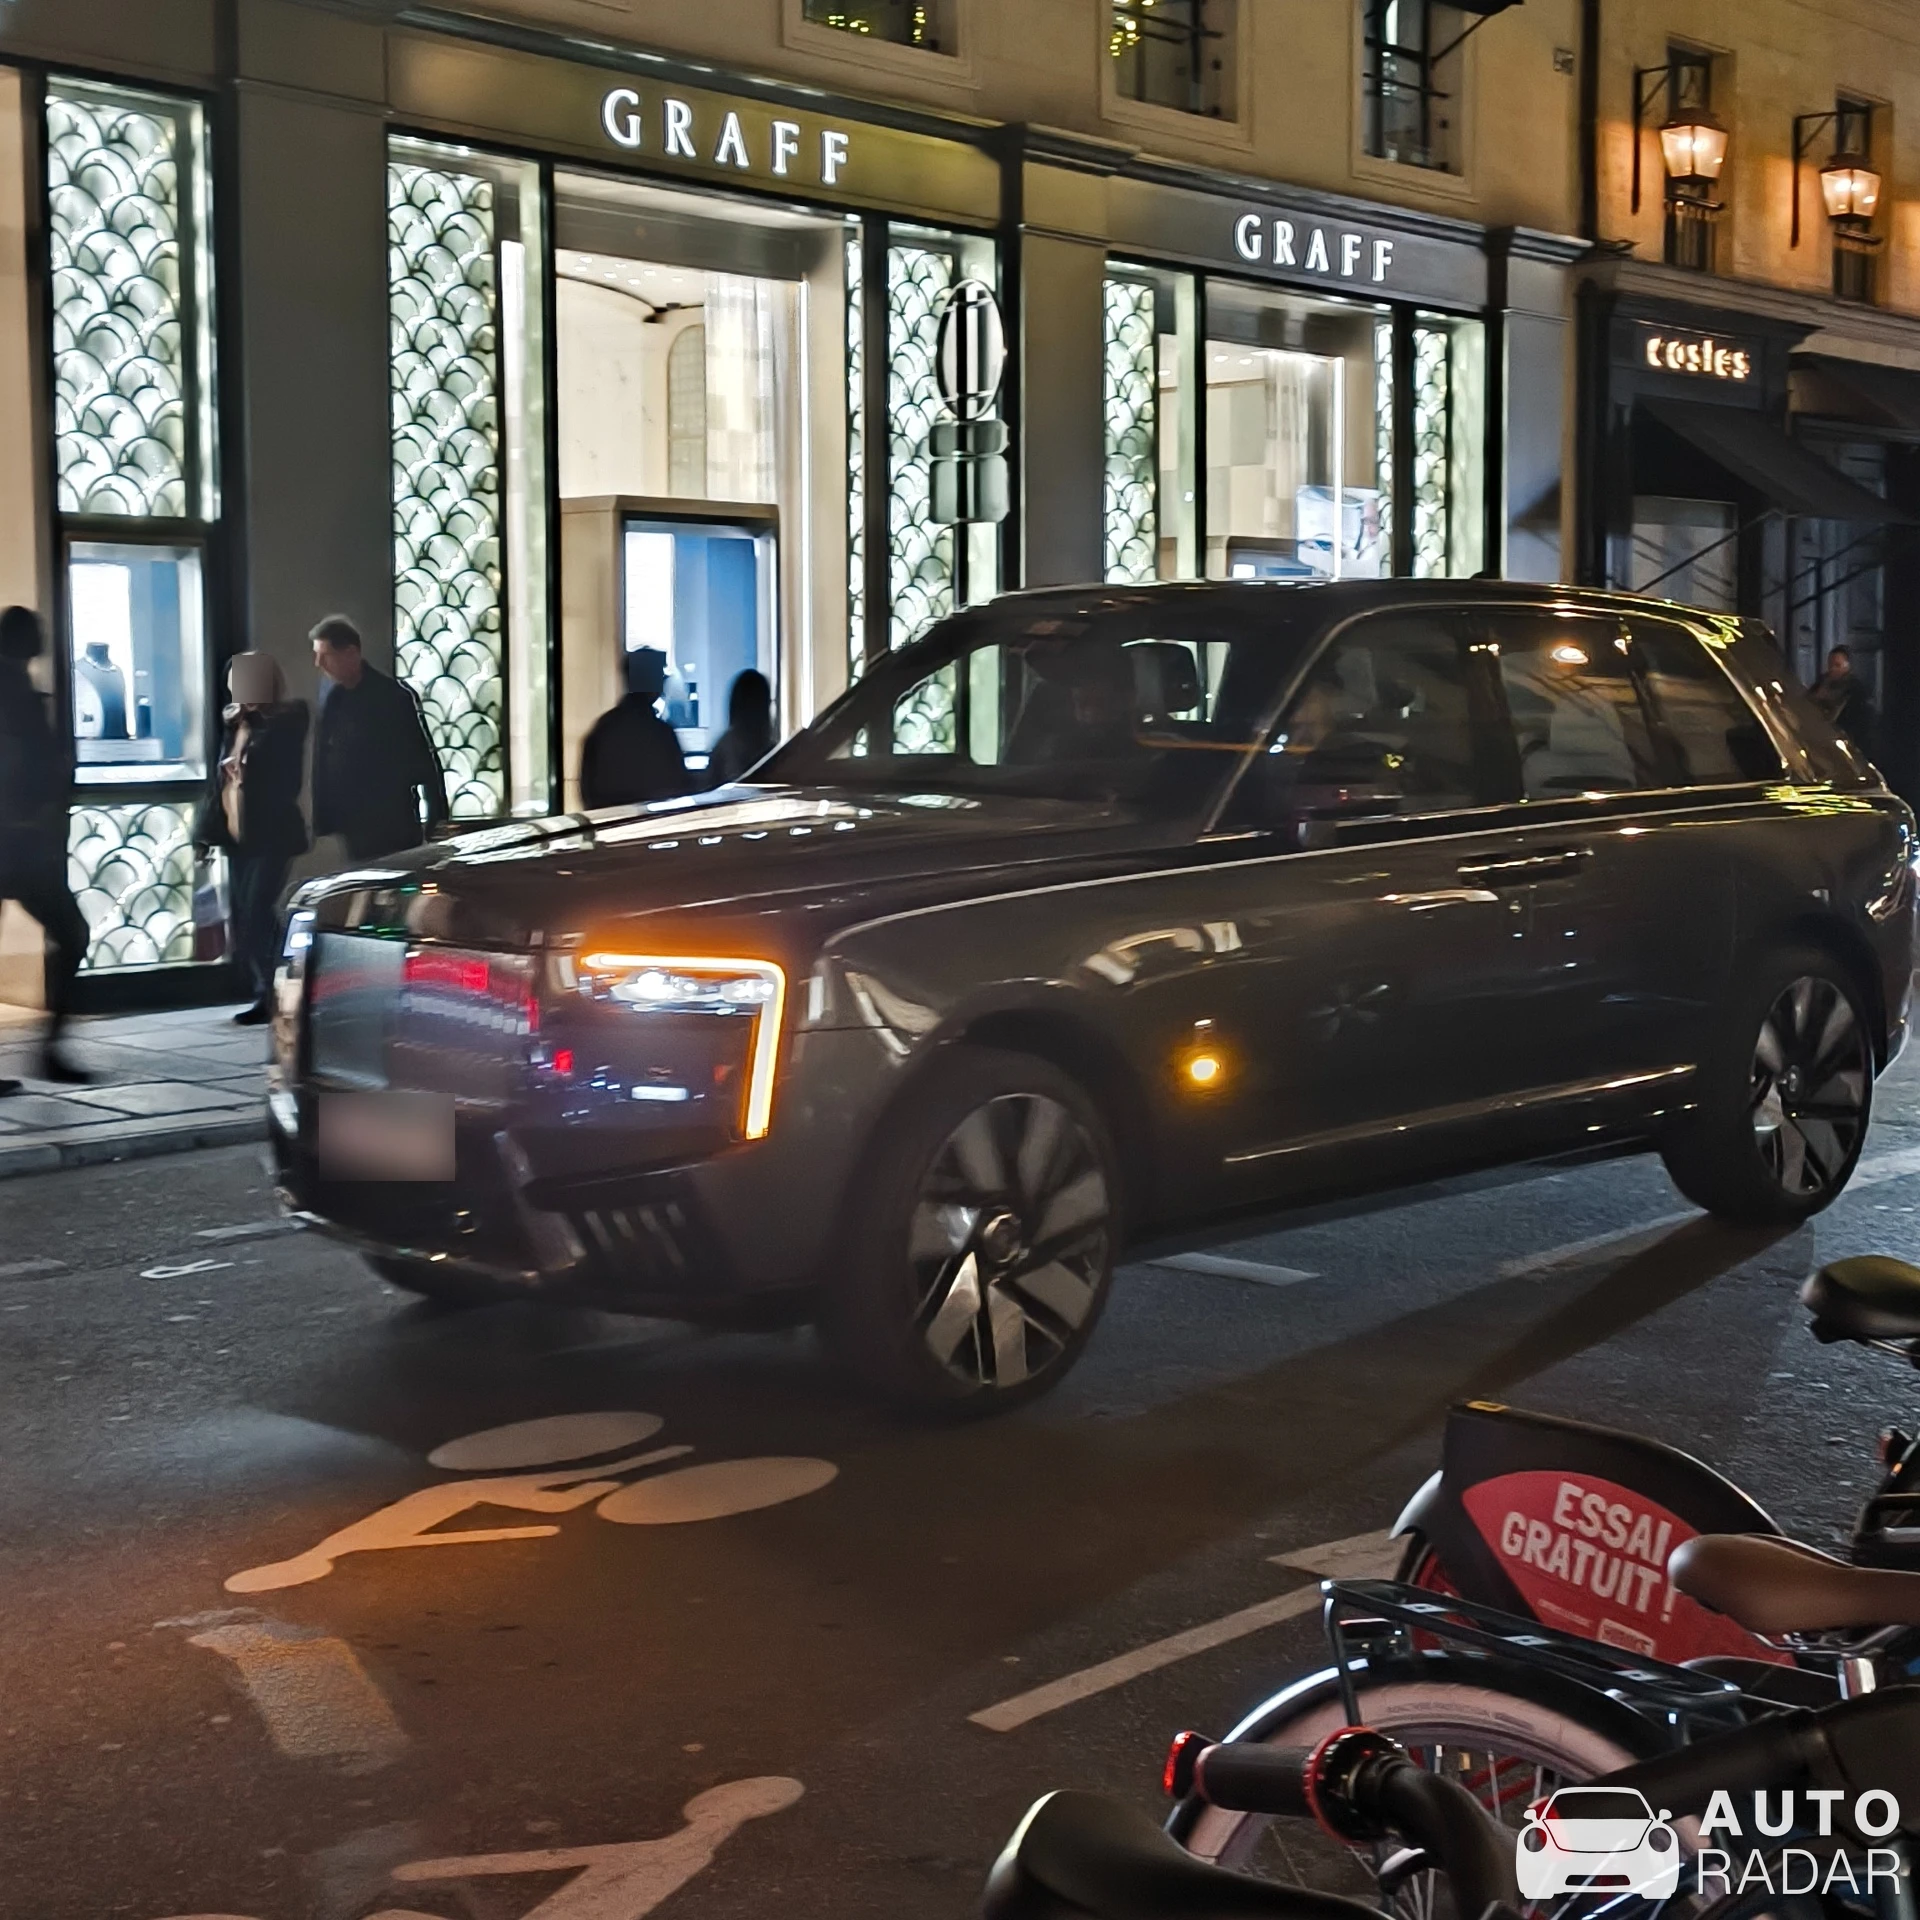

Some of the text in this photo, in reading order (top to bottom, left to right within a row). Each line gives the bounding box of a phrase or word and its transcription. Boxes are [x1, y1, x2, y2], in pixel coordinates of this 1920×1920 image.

[602, 88, 849, 185] GRAFF
[1235, 213, 1394, 282] GRAFF
[1552, 1481, 1673, 1567] ESSAI
